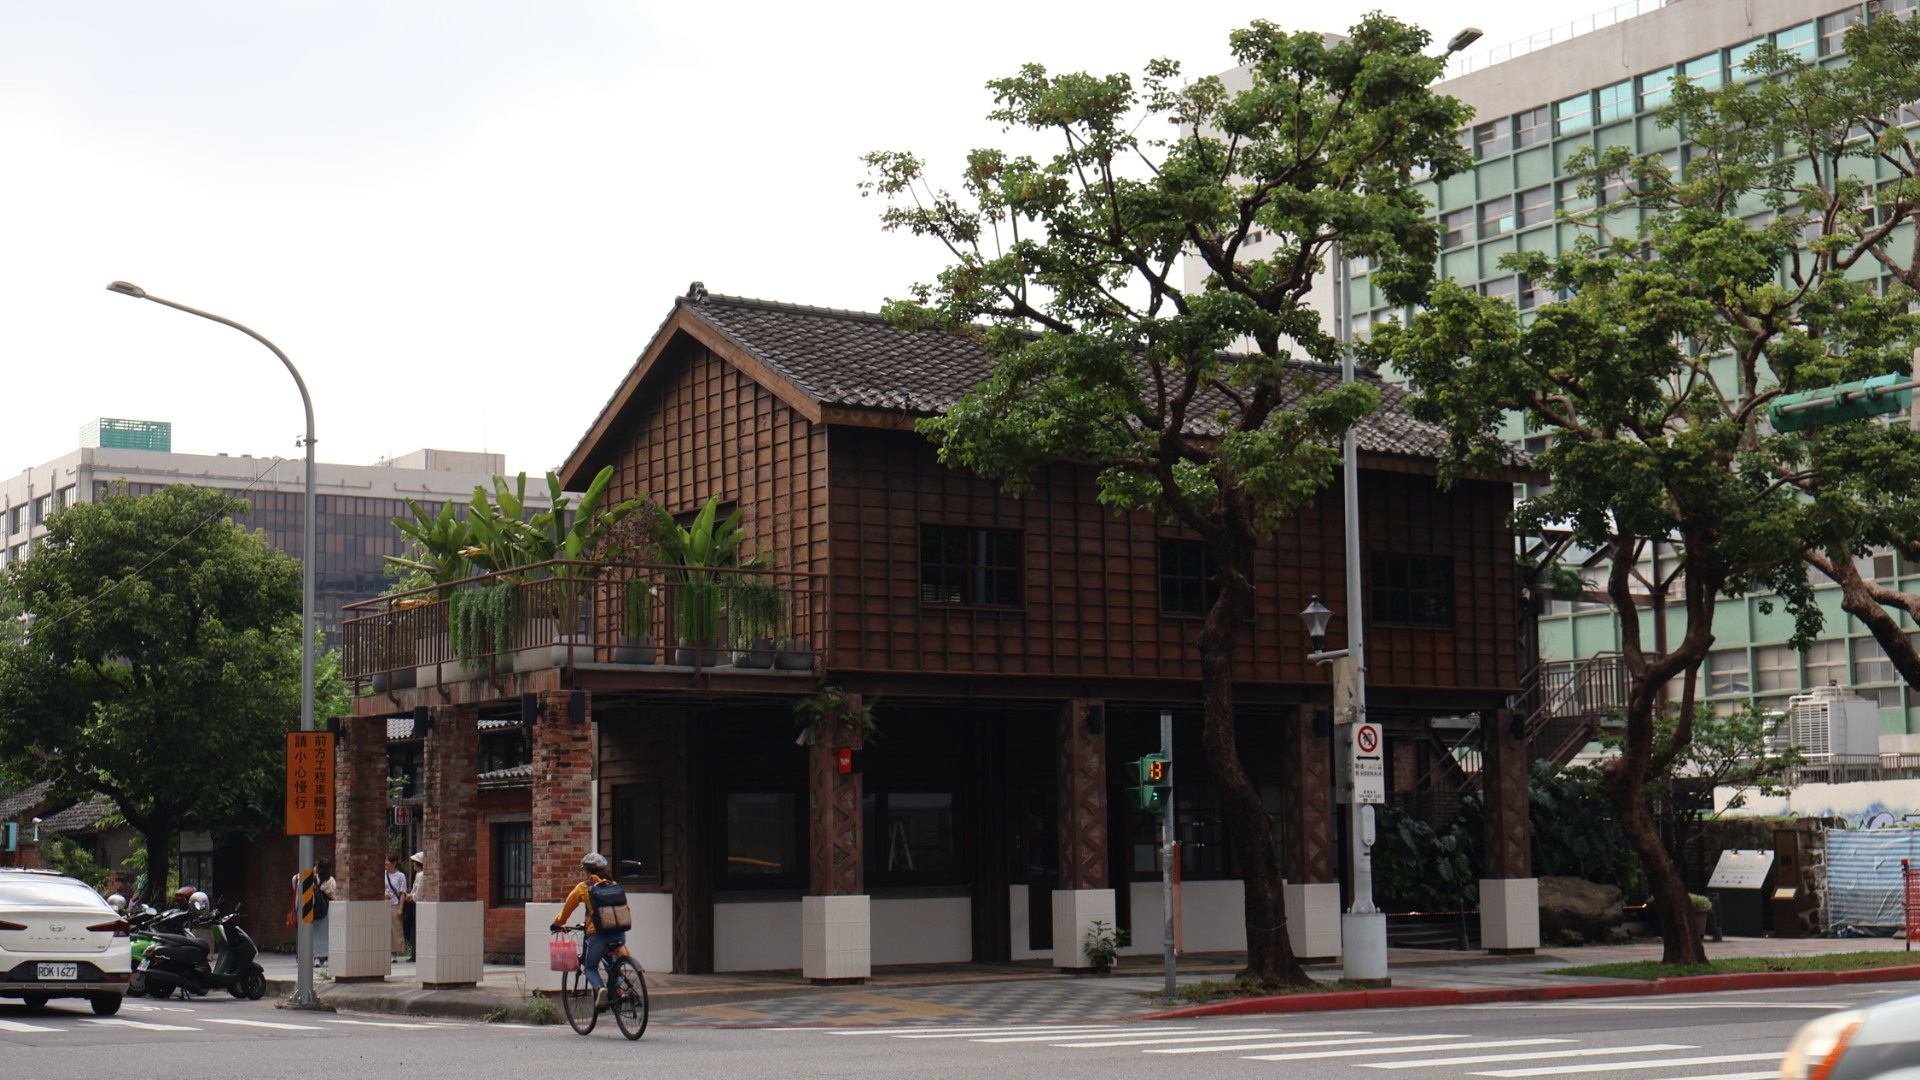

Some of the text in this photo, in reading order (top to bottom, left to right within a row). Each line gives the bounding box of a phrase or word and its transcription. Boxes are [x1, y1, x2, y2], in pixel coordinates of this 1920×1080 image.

[294, 735, 307, 809] 請小心慢行
[314, 735, 326, 832] 前方工程車輛進出
[1150, 761, 1161, 780] 13
